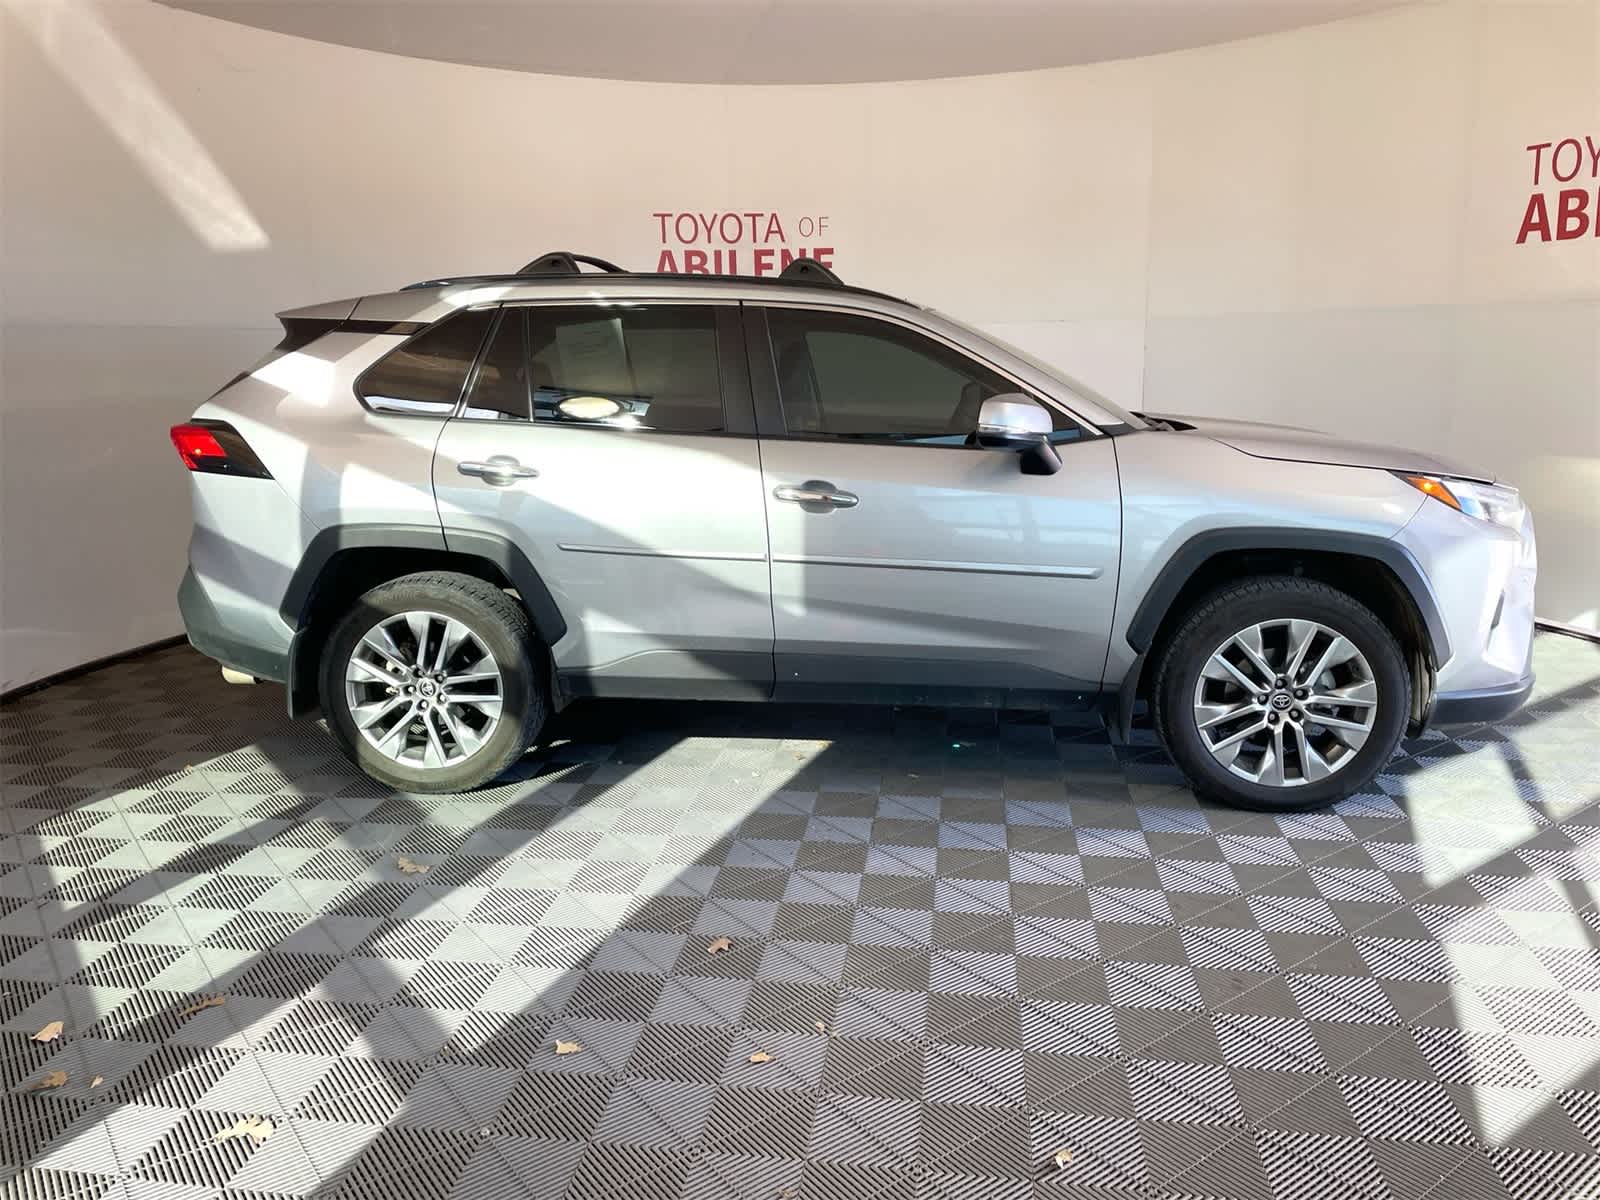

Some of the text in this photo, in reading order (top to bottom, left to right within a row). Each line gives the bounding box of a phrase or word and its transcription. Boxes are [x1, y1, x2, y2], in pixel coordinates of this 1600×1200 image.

[1526, 136, 1600, 186] TOY
[653, 213, 829, 244] TOYOTA OF
